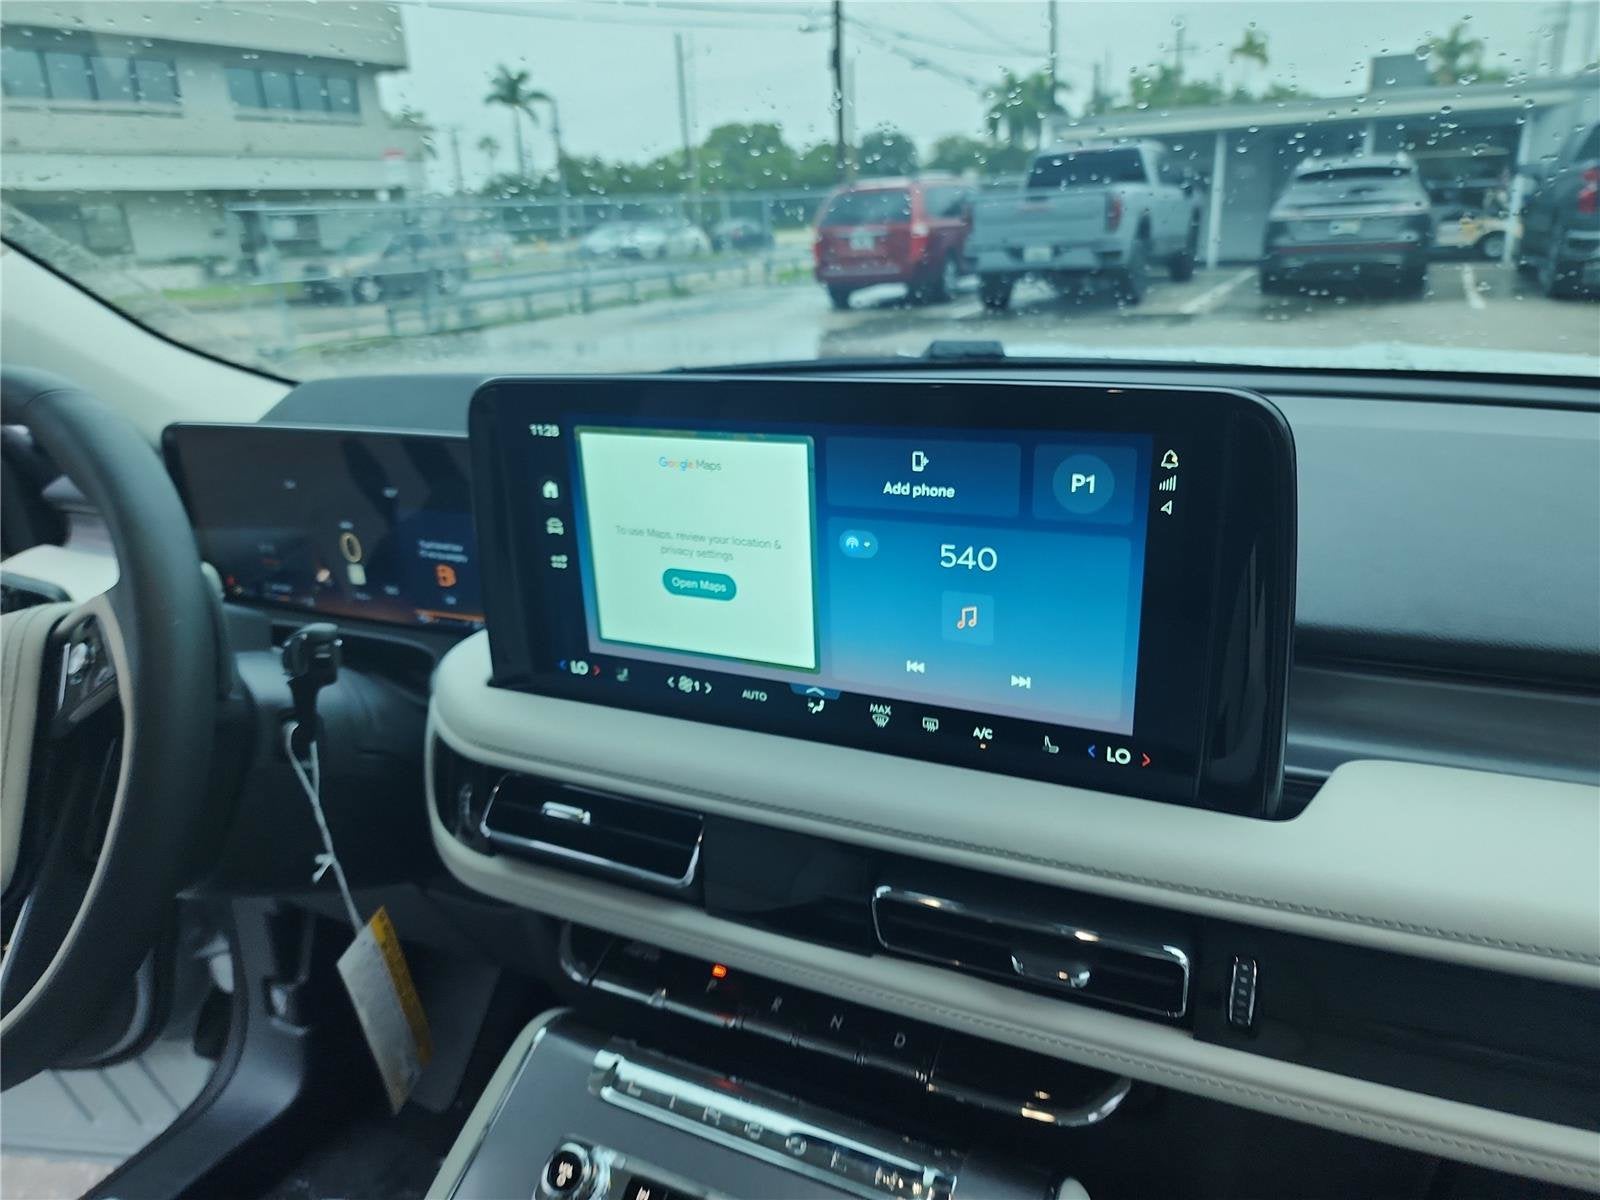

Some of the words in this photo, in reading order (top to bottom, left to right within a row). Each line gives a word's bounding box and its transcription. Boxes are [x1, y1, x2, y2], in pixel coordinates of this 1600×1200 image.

[658, 456, 695, 472] Google
[696, 459, 722, 473] Maps
[883, 481, 910, 496] Add
[912, 482, 956, 499] phone
[1071, 473, 1097, 494] P1
[615, 525, 626, 536] To
[630, 528, 646, 537] use
[676, 532, 706, 543] review
[708, 535, 730, 546] your
[732, 536, 772, 549] location
[773, 539, 783, 550] &
[660, 546, 695, 559] privacy
[697, 549, 734, 563] settings
[940, 543, 998, 572] 540
[671, 576, 698, 589] Open
[700, 579, 727, 593] Maps
[569, 660, 589, 675] LO
[741, 689, 768, 702] AUTO
[870, 703, 892, 716] MAX
[973, 727, 993, 740] A/C
[1106, 746, 1132, 765] LO
[771, 996, 783, 1013] R
[830, 1014, 844, 1030] N
[894, 1032, 906, 1048] D
